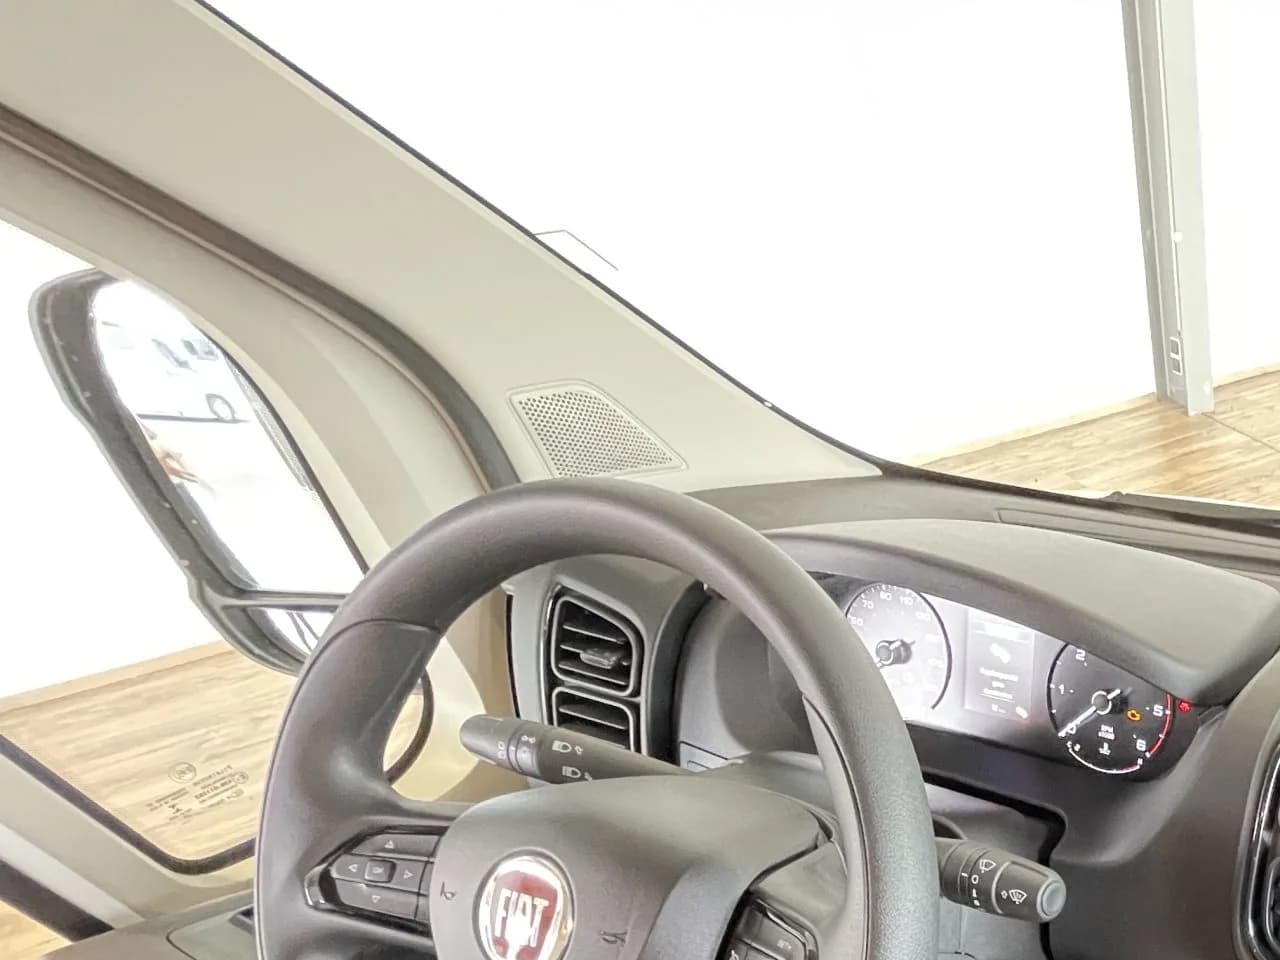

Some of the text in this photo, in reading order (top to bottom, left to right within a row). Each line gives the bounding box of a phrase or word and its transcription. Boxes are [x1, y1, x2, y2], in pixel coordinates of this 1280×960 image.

[1075, 648, 1086, 661] 2
[1059, 684, 1065, 694] 1
[1152, 704, 1163, 717] 5
[1136, 739, 1146, 752] 6
[494, 887, 550, 948] FIAT
